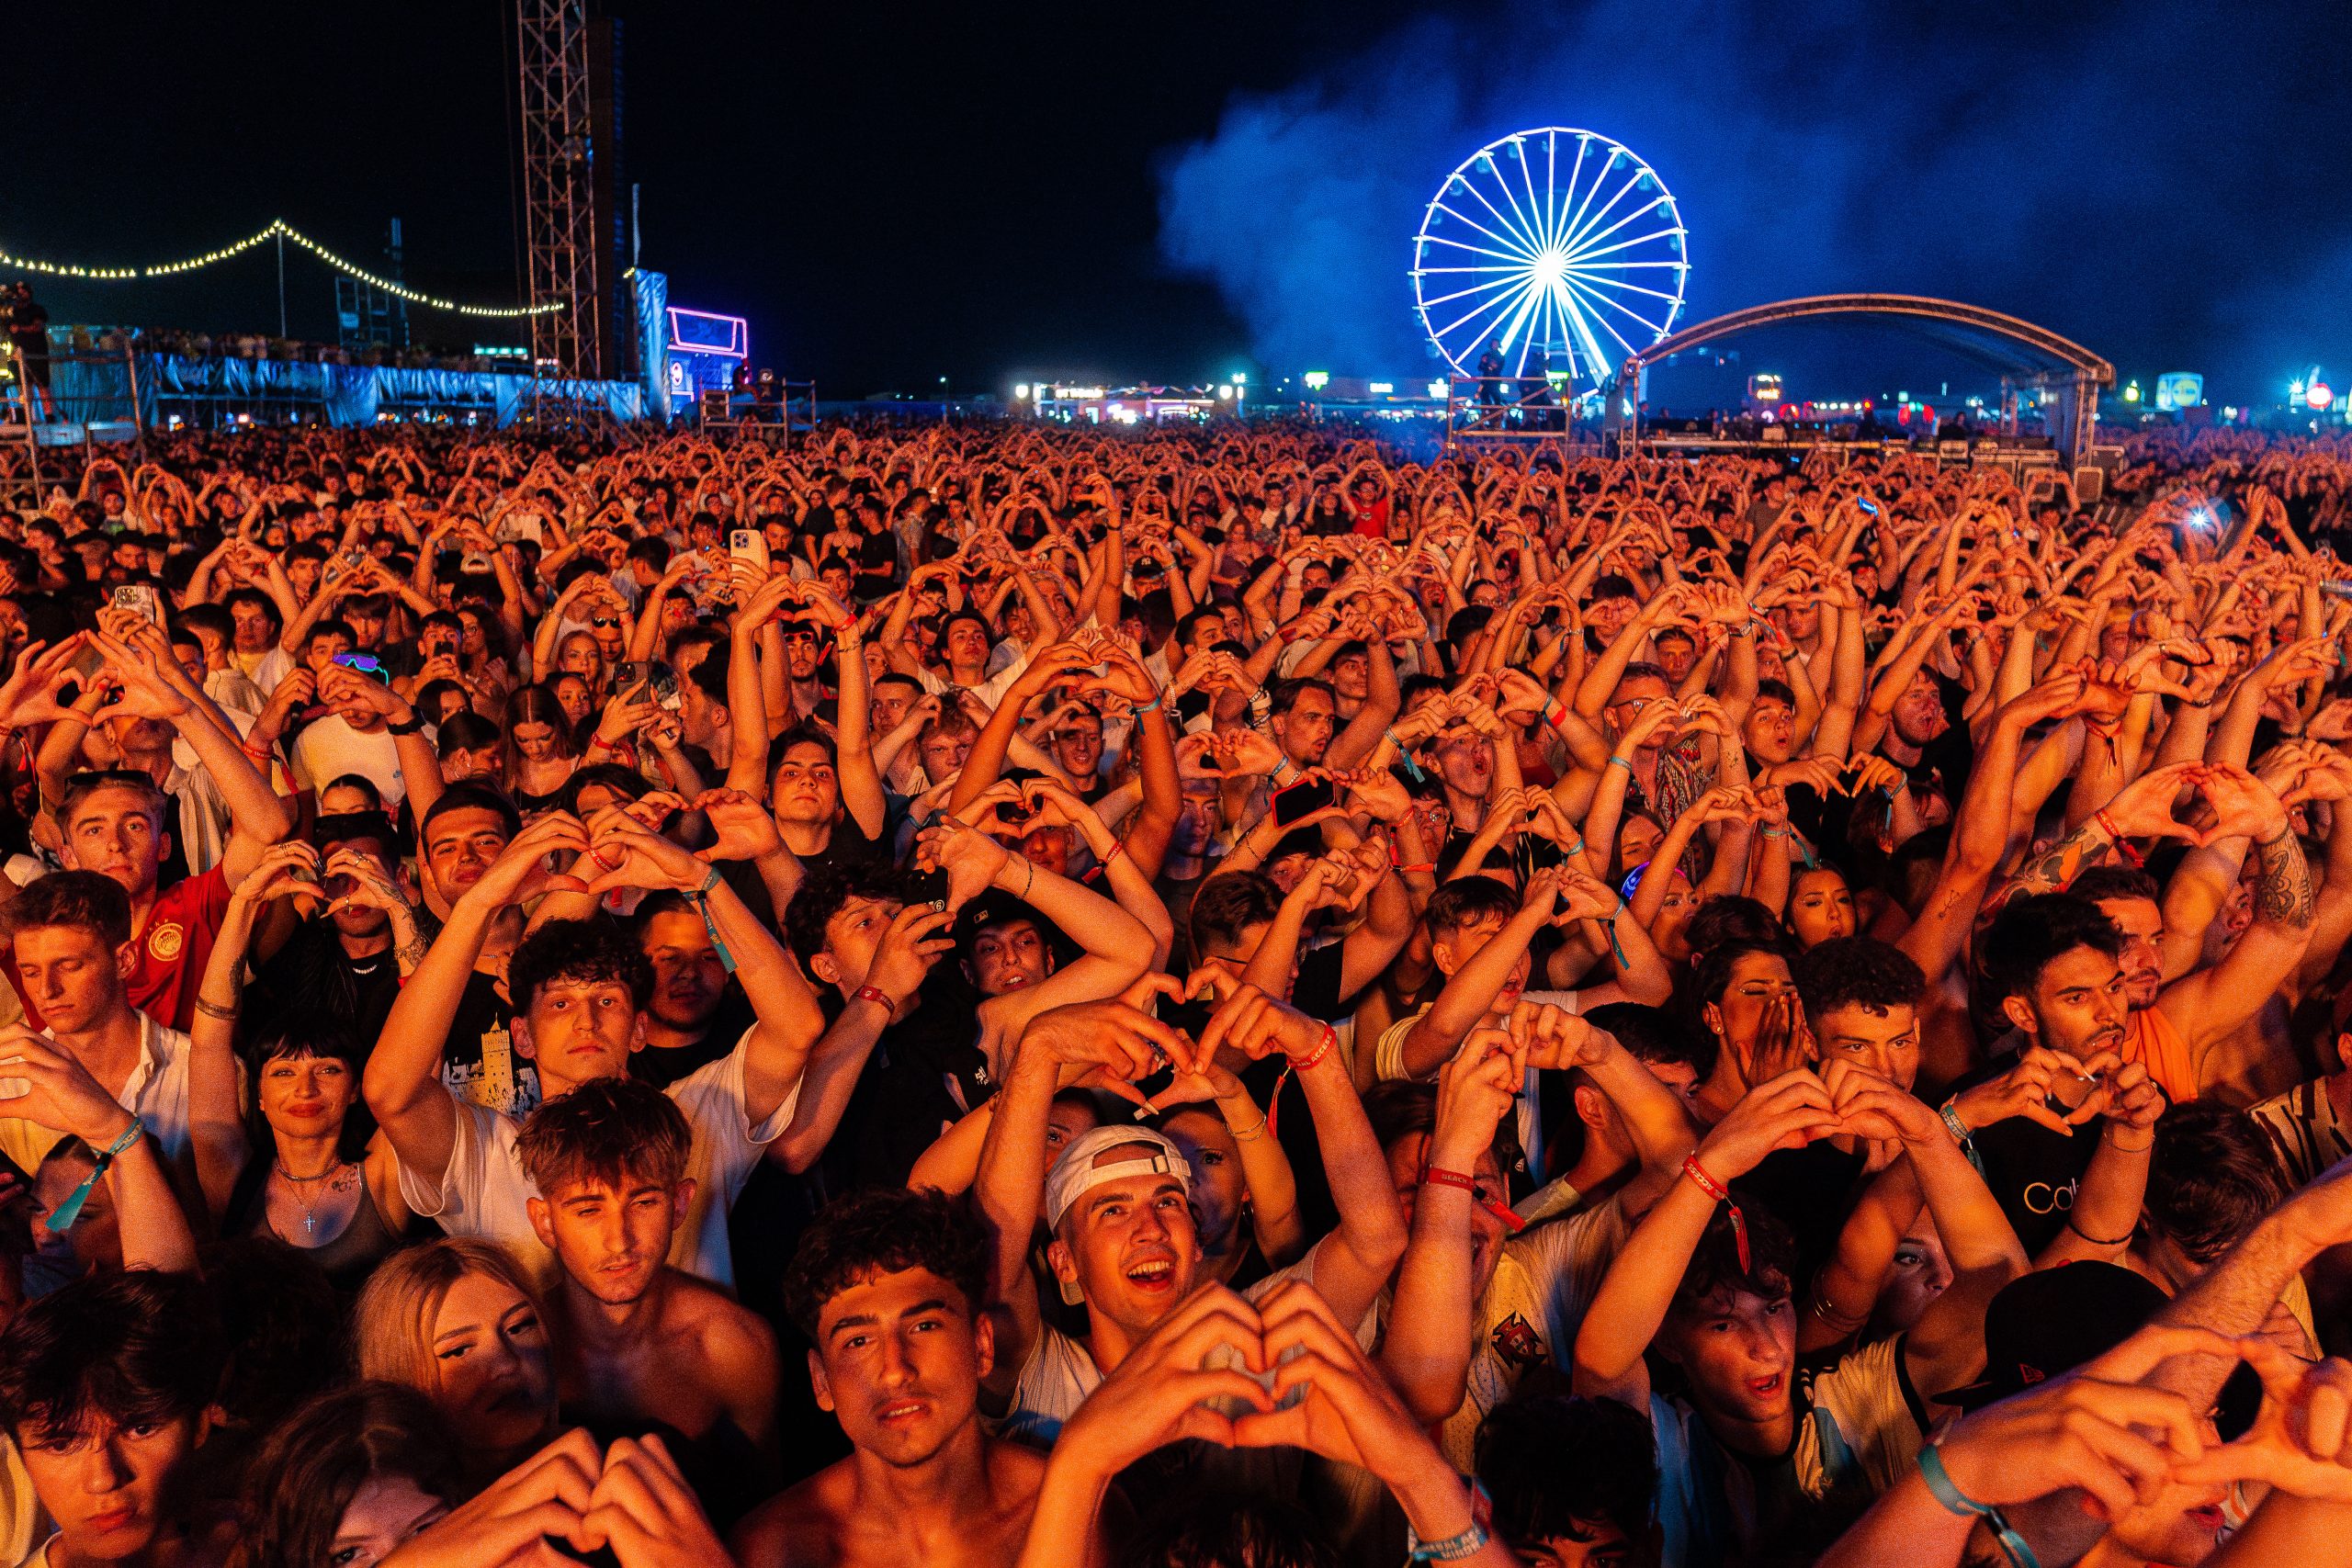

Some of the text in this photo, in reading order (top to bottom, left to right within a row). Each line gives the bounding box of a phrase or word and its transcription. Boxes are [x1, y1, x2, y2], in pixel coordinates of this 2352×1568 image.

[1311, 1033, 1332, 1063] ACCESS
[1687, 1163, 1714, 1190] ACCESS
[2024, 1177, 2079, 1214] Cal
